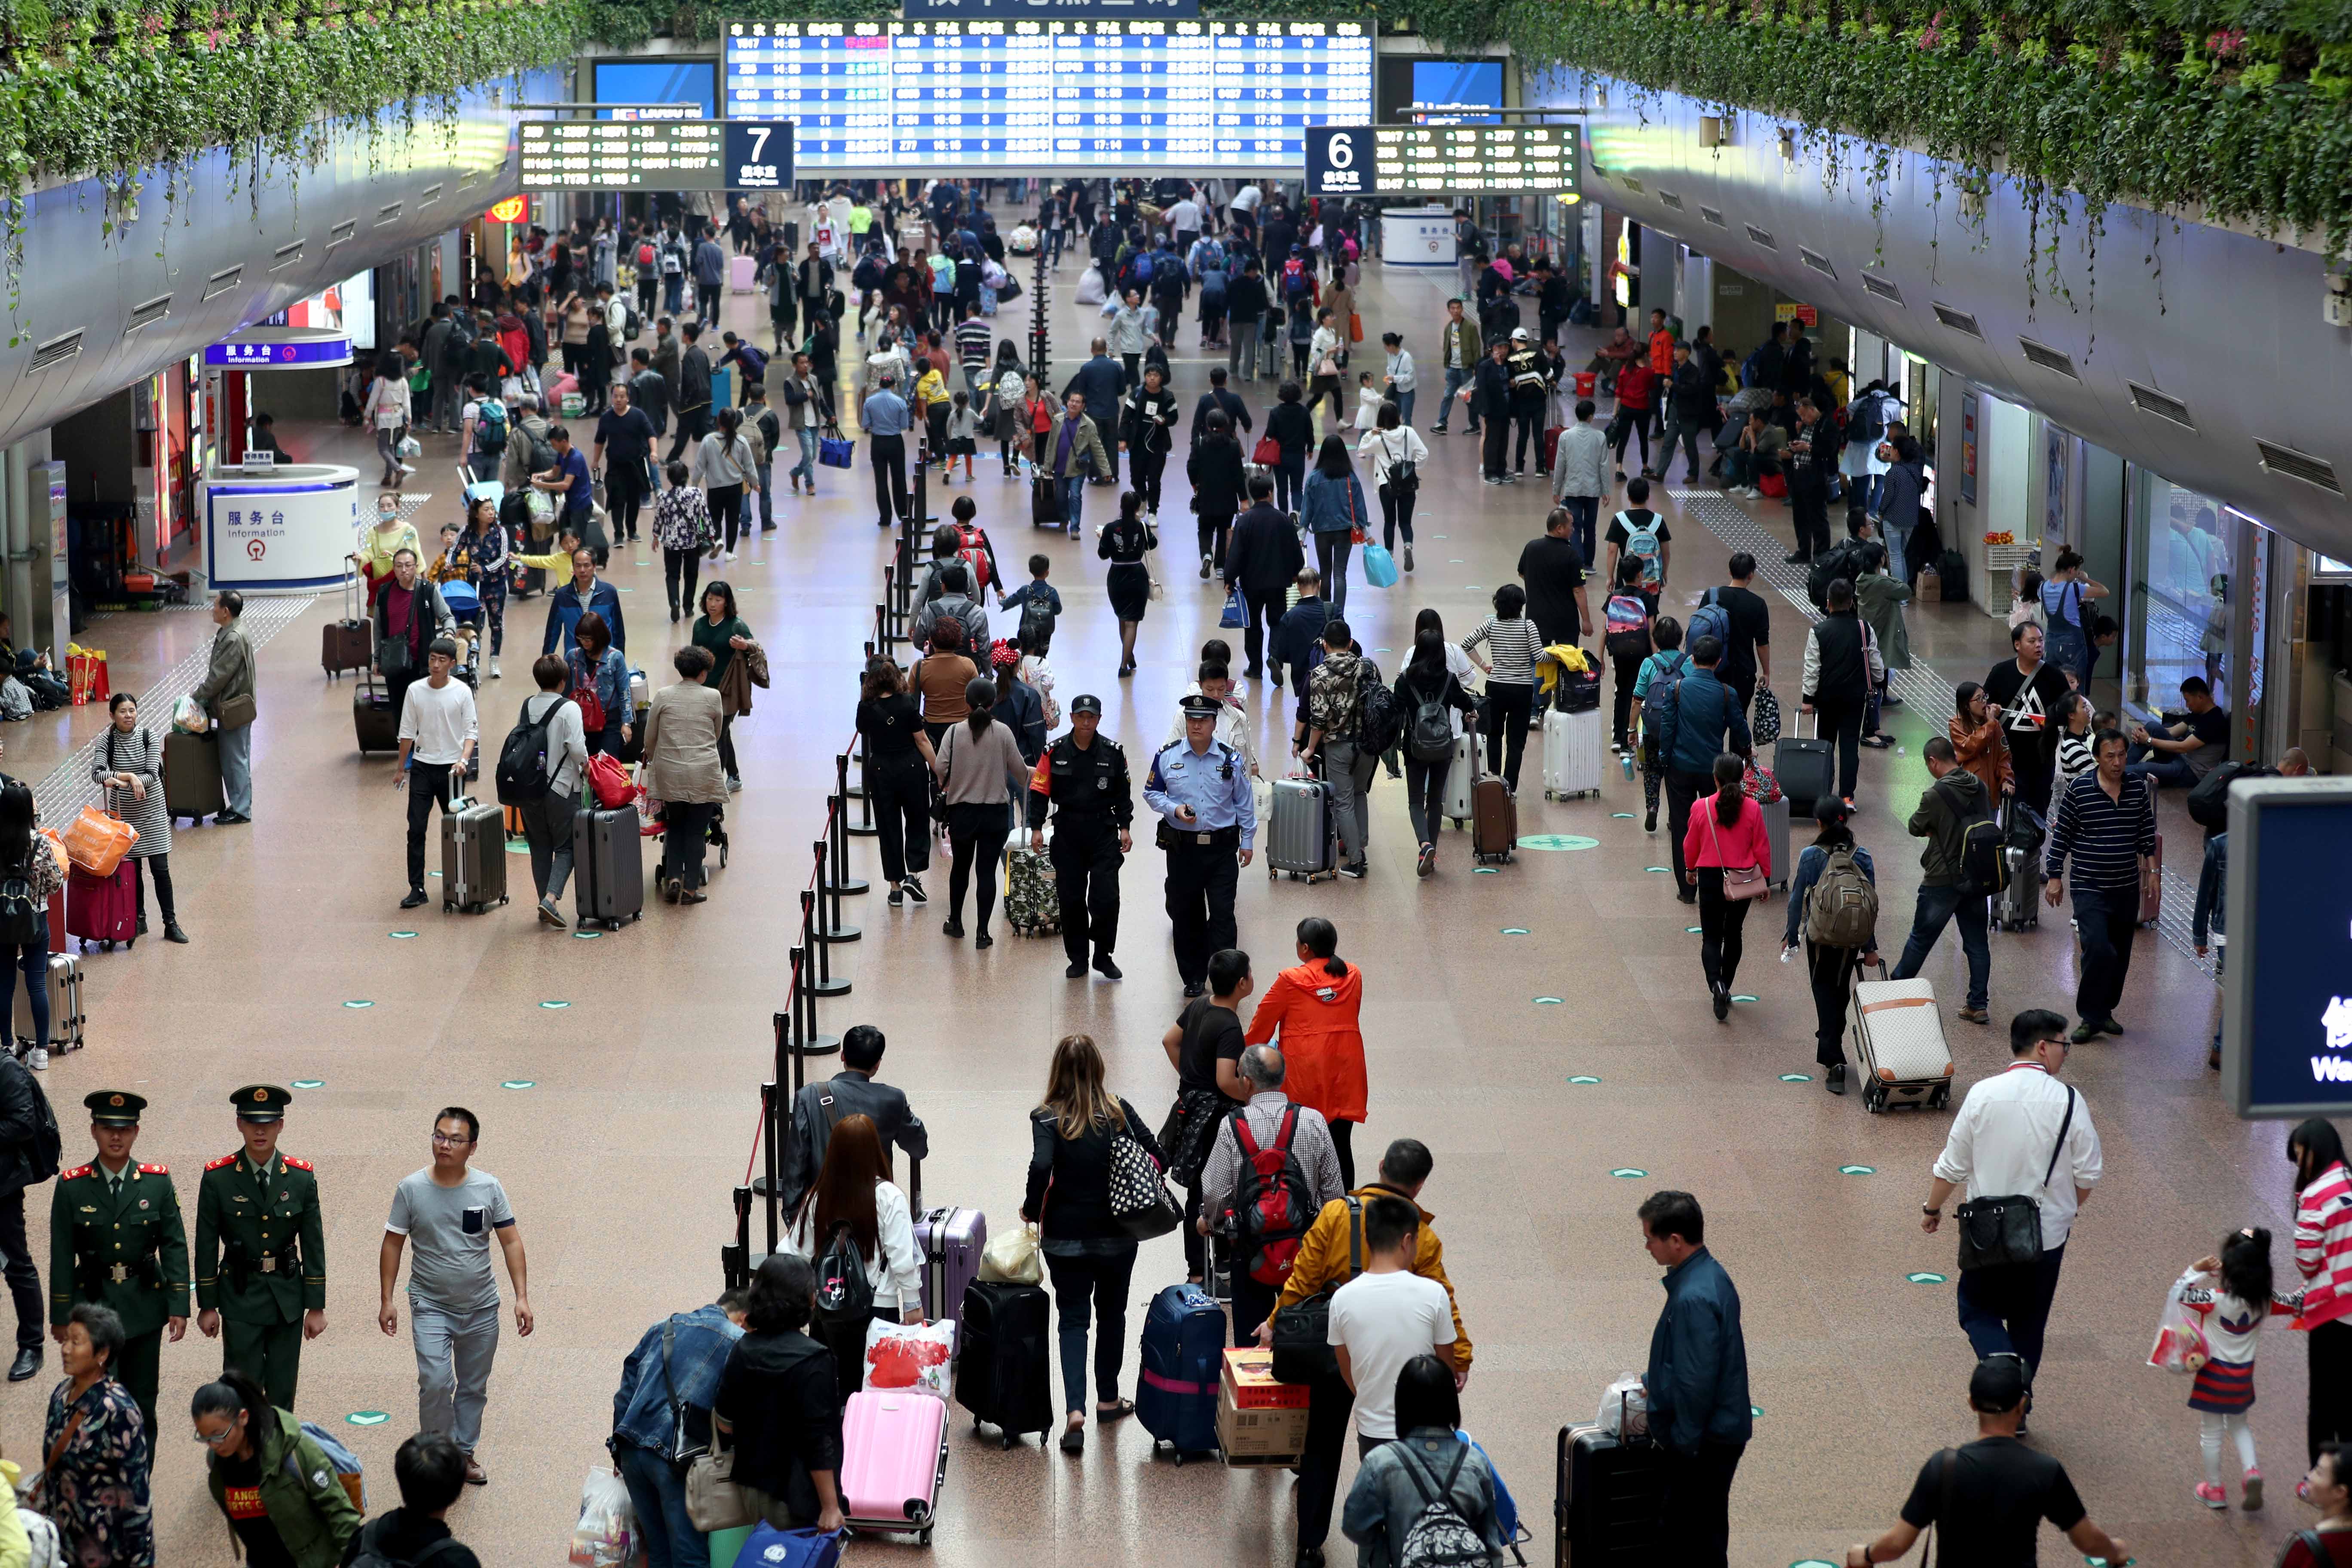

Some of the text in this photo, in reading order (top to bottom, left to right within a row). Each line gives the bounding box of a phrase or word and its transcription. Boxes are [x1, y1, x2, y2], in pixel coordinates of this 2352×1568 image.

[845, 37, 888, 49] 停止检票
[1141, 62, 1151, 73] 11
[820, 116, 830, 126] 11
[1141, 114, 1151, 124] 11
[747, 128, 771, 162] 7
[1328, 133, 1353, 168] 6
[226, 344, 271, 356] 服务台
[228, 510, 284, 526] 服务台
[228, 529, 285, 538] Information
